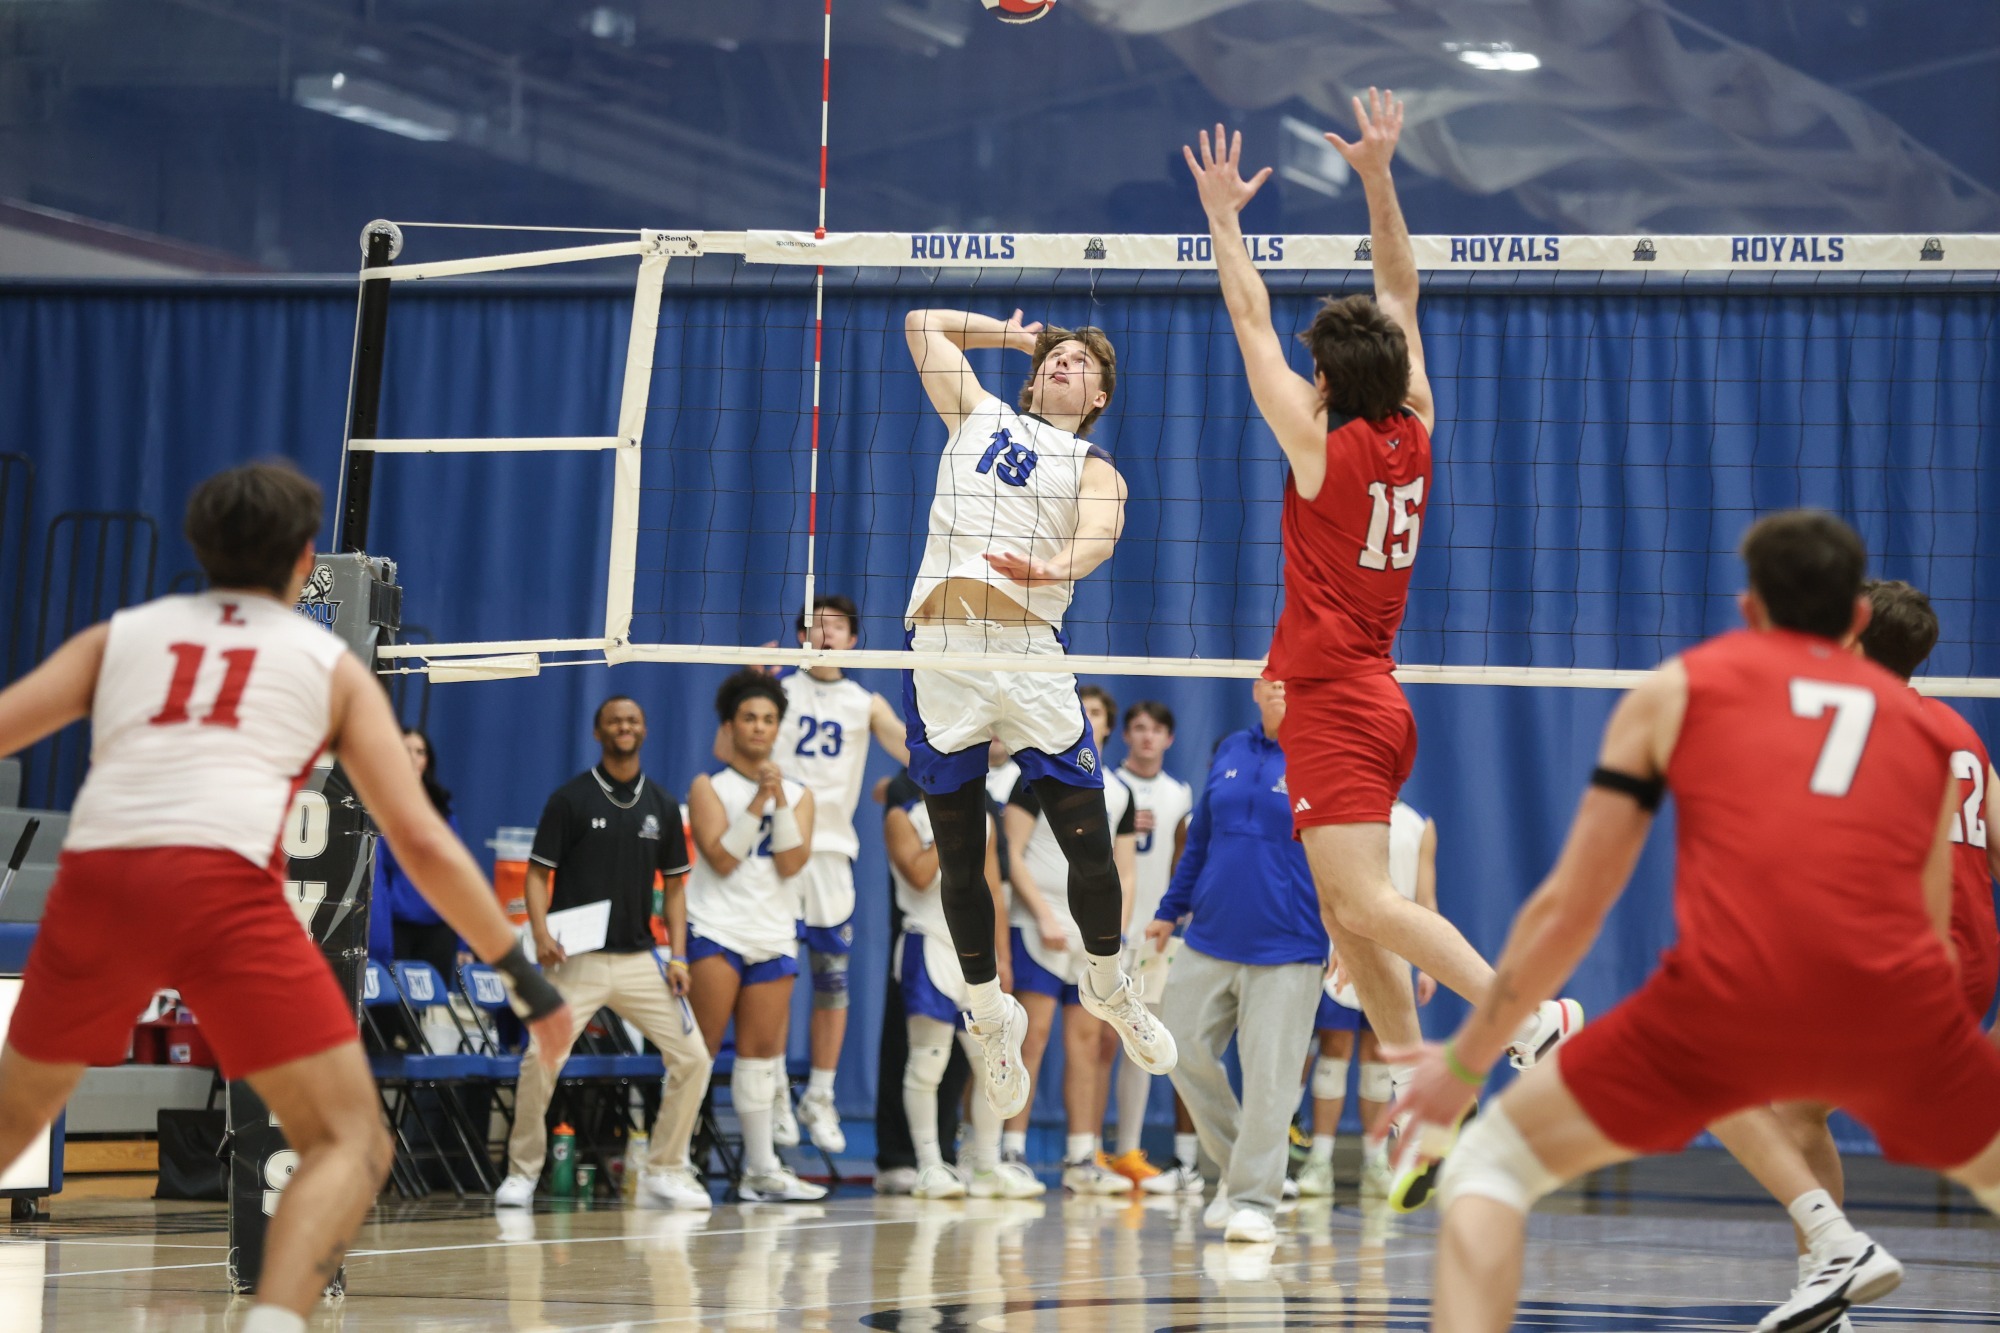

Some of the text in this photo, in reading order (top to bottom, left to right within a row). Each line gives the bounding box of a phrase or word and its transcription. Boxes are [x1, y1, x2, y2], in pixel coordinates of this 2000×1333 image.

[911, 235, 1015, 260] ROYALS
[1177, 237, 1284, 262] ROLS
[1450, 237, 1560, 262] ROYALS
[1731, 237, 1844, 262] ROYALS
[975, 427, 1039, 488] 19
[1357, 475, 1425, 571] 15
[218, 603, 246, 626] L
[148, 641, 258, 728] 11
[795, 715, 843, 758] 23
[1788, 677, 1876, 798] 7
[1947, 749, 1987, 849] 2
